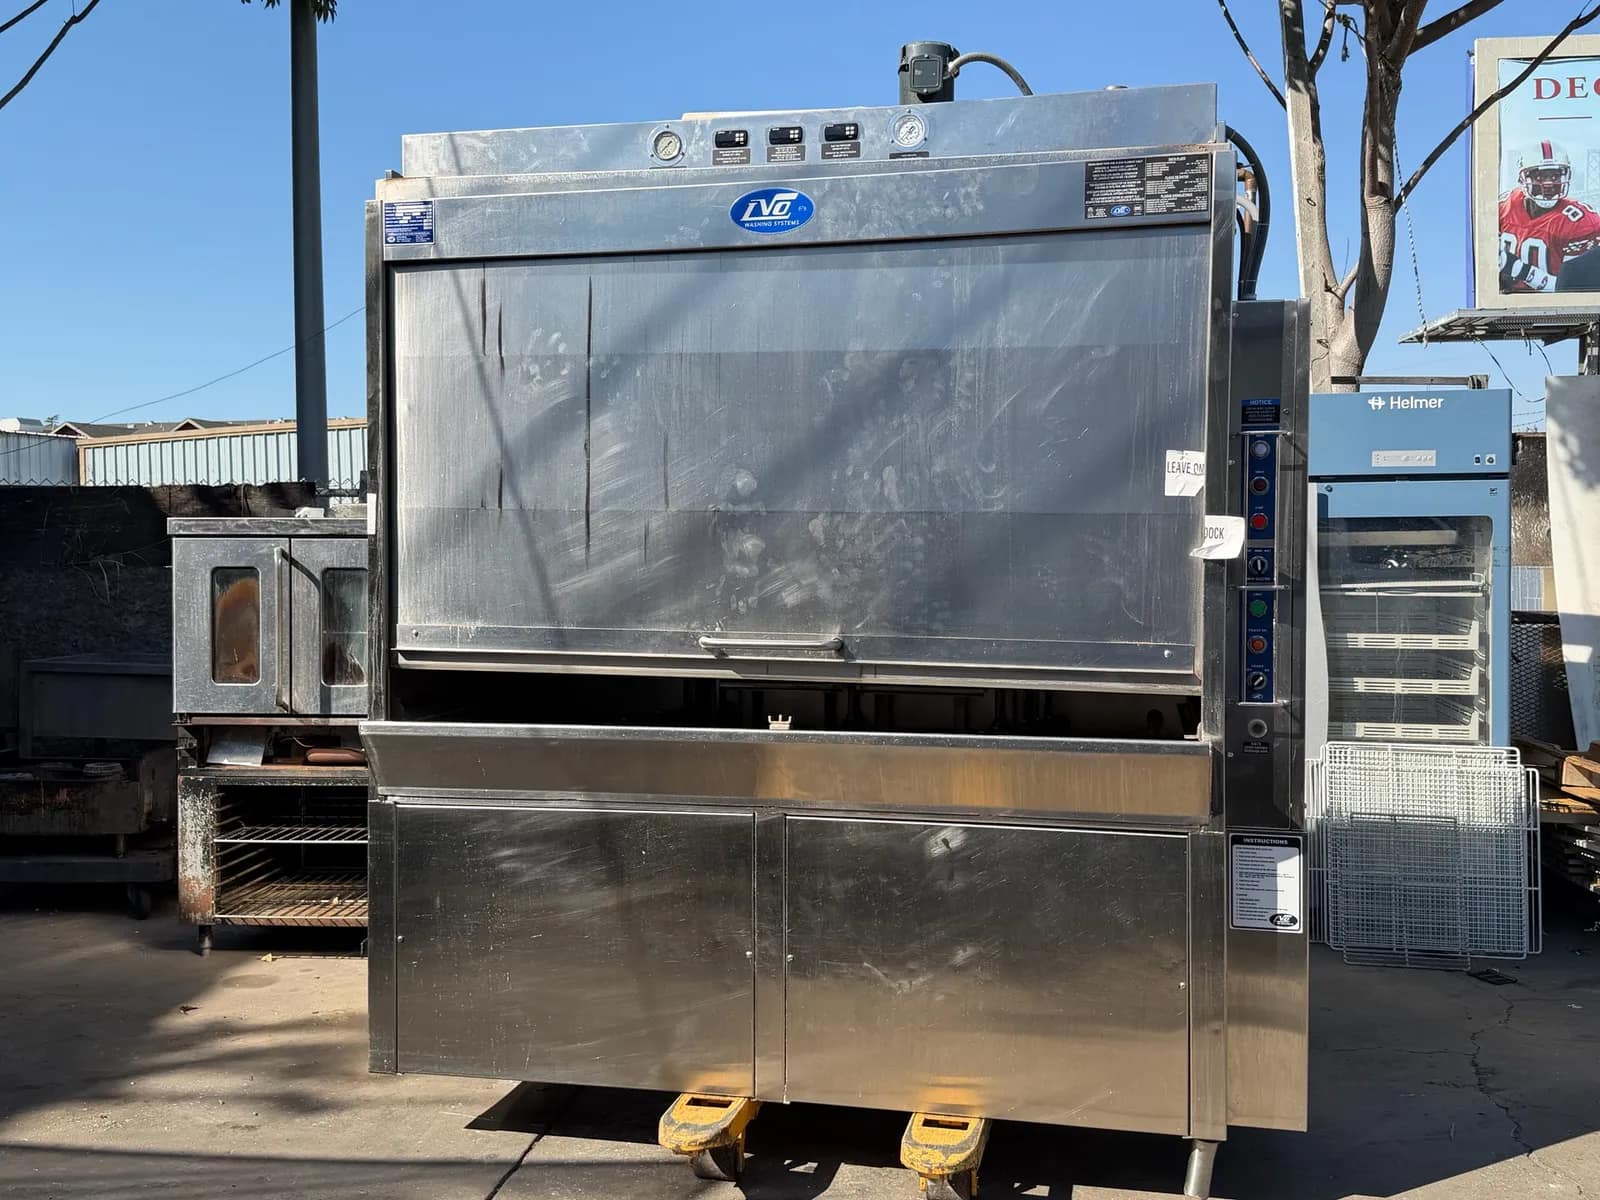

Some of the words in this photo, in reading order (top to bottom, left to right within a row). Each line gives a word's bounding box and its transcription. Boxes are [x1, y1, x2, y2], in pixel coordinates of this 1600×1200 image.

[1532, 76, 1600, 100] DE
[1389, 395, 1445, 410] Helmer
[1167, 461, 1191, 474] LEAVE
[1243, 837, 1289, 845] INSTRUCTIONS
